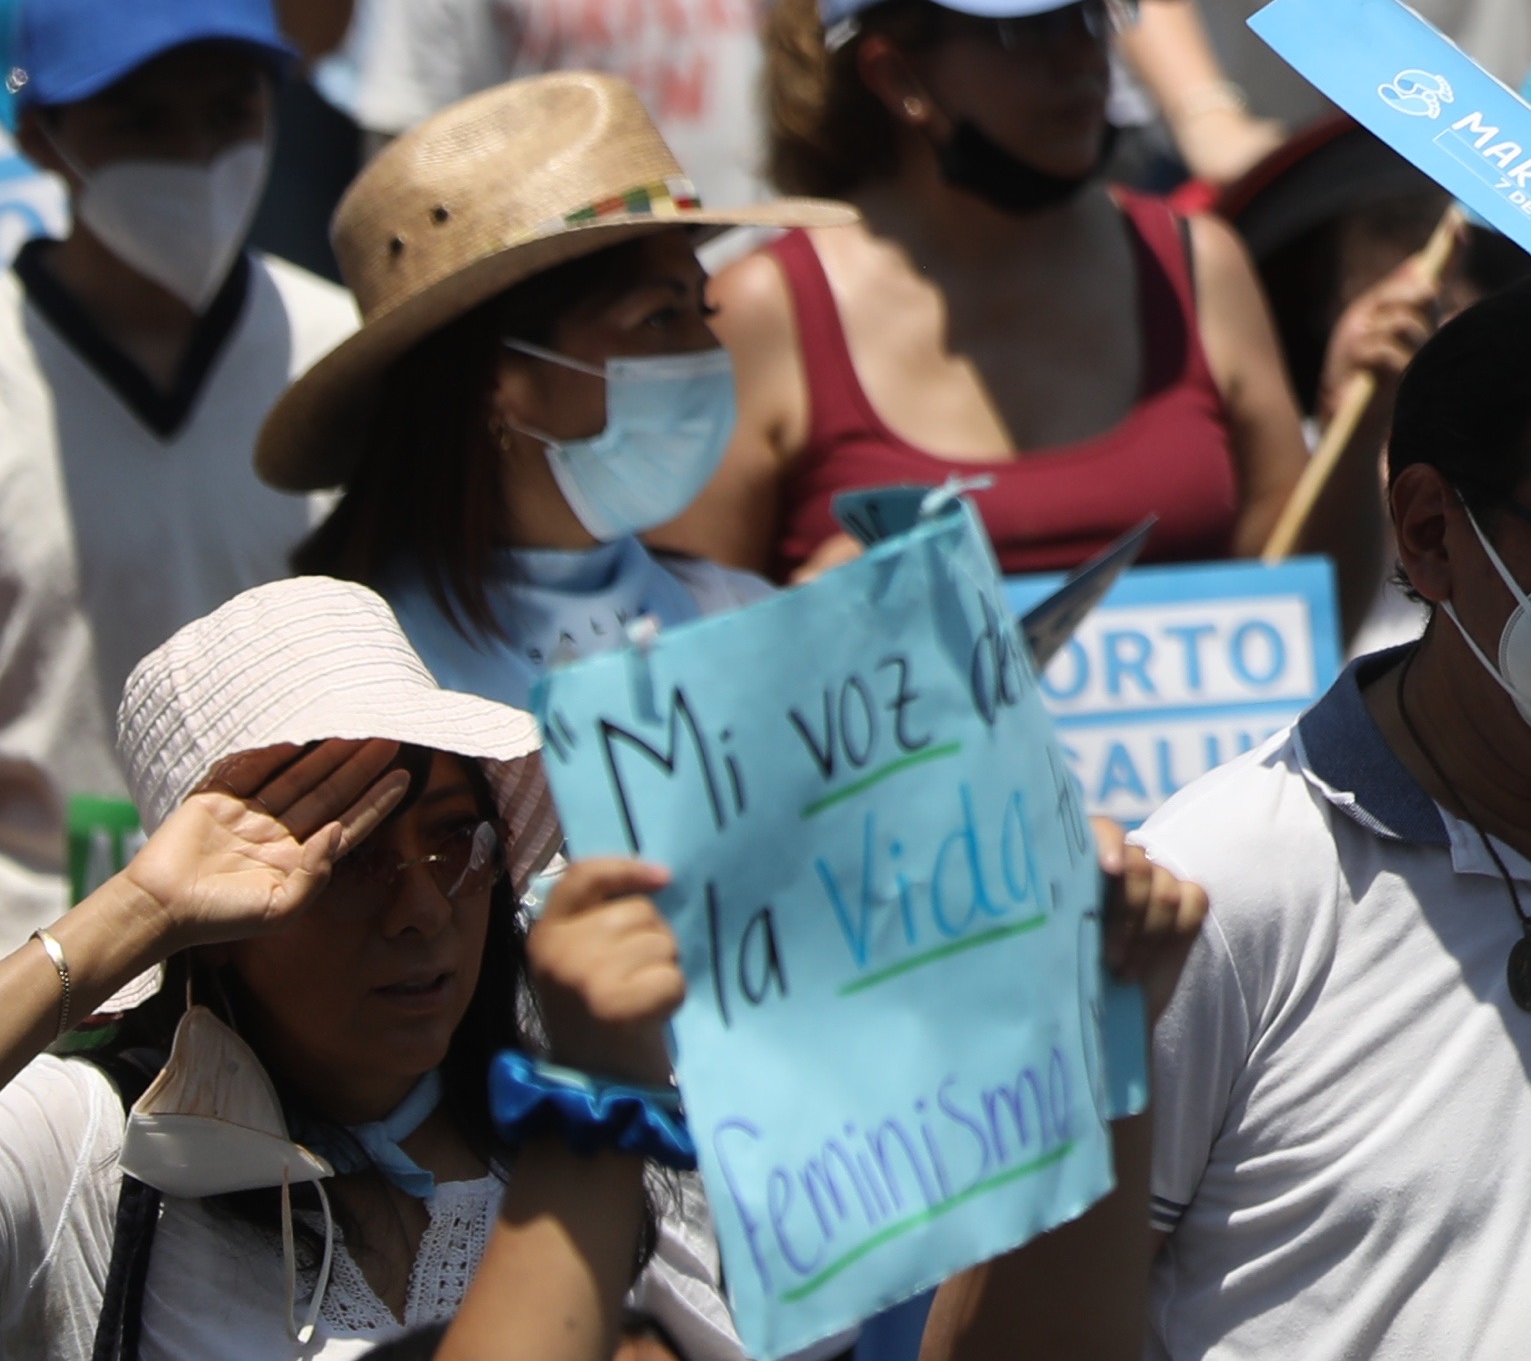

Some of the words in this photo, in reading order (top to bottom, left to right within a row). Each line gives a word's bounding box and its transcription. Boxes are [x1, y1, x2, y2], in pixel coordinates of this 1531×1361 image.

[1494, 177, 1513, 190] 7
[787, 656, 932, 781] voz
[704, 880, 790, 1032] la
